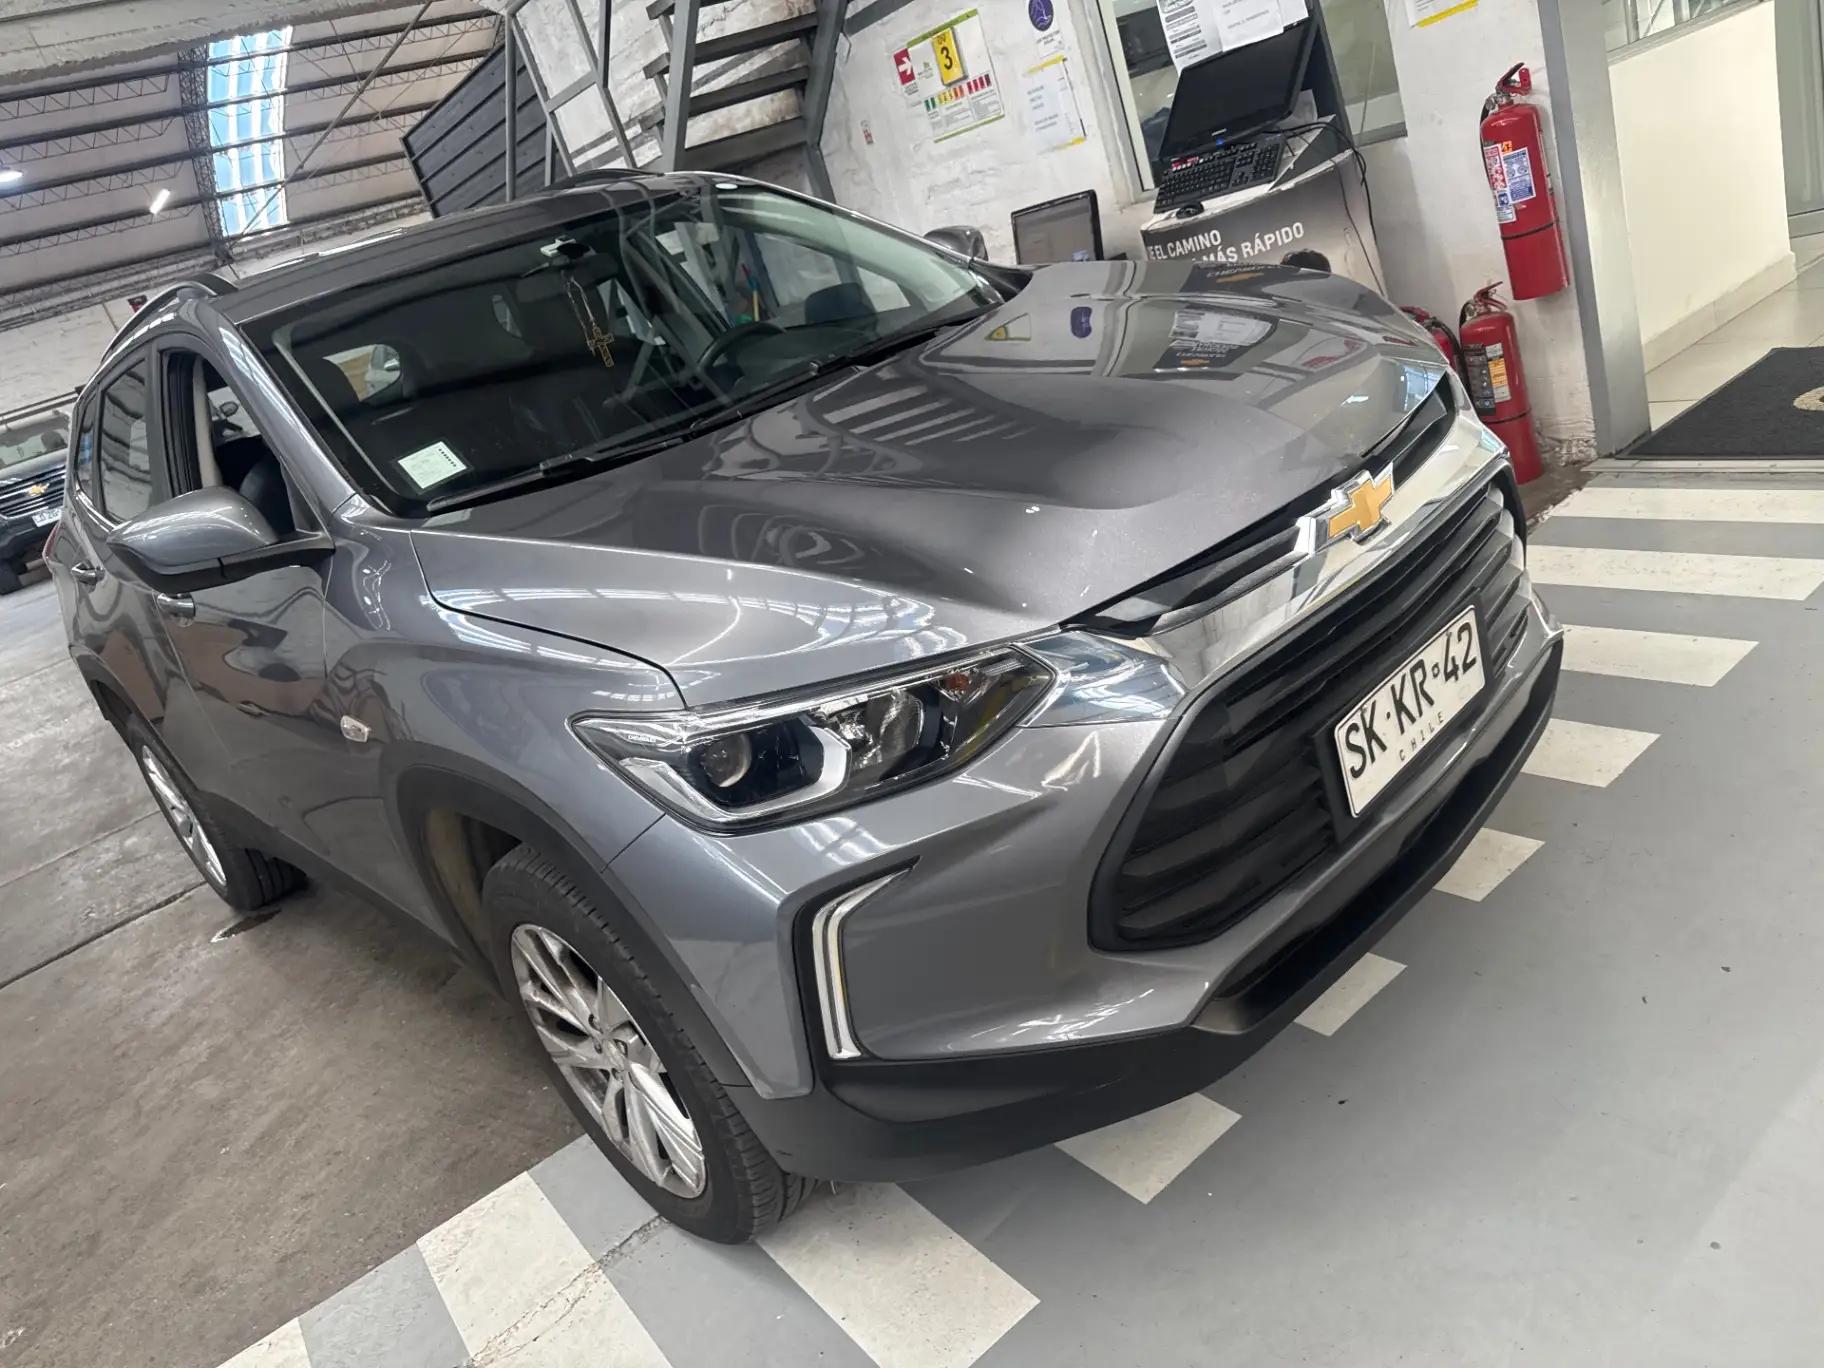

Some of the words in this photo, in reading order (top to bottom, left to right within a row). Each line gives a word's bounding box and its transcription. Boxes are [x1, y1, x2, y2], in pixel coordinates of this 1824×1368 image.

[940, 46, 953, 70] 3
[1155, 244, 1168, 260] EL
[1167, 230, 1222, 258] CAMINO
[1241, 222, 1304, 258] RÁPIDO
[1399, 711, 1444, 761] CHILE
